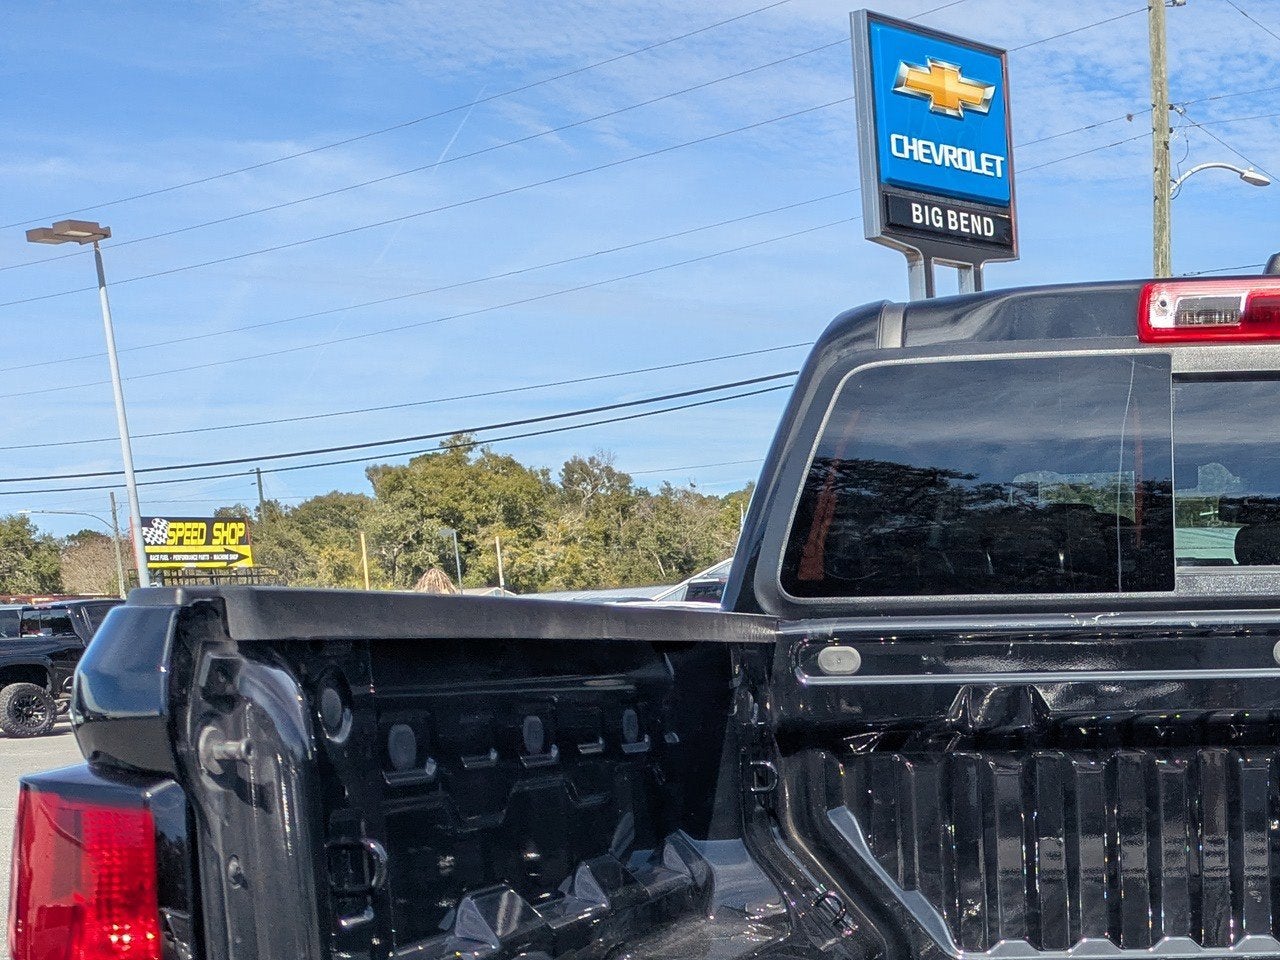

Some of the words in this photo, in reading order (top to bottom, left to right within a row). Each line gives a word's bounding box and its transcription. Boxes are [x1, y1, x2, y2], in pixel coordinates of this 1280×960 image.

[890, 133, 1005, 178] CHEVROLET
[911, 202, 944, 228] BIG
[947, 209, 995, 237] BEND
[166, 522, 207, 545] SPEED
[212, 522, 246, 545] SHOP
